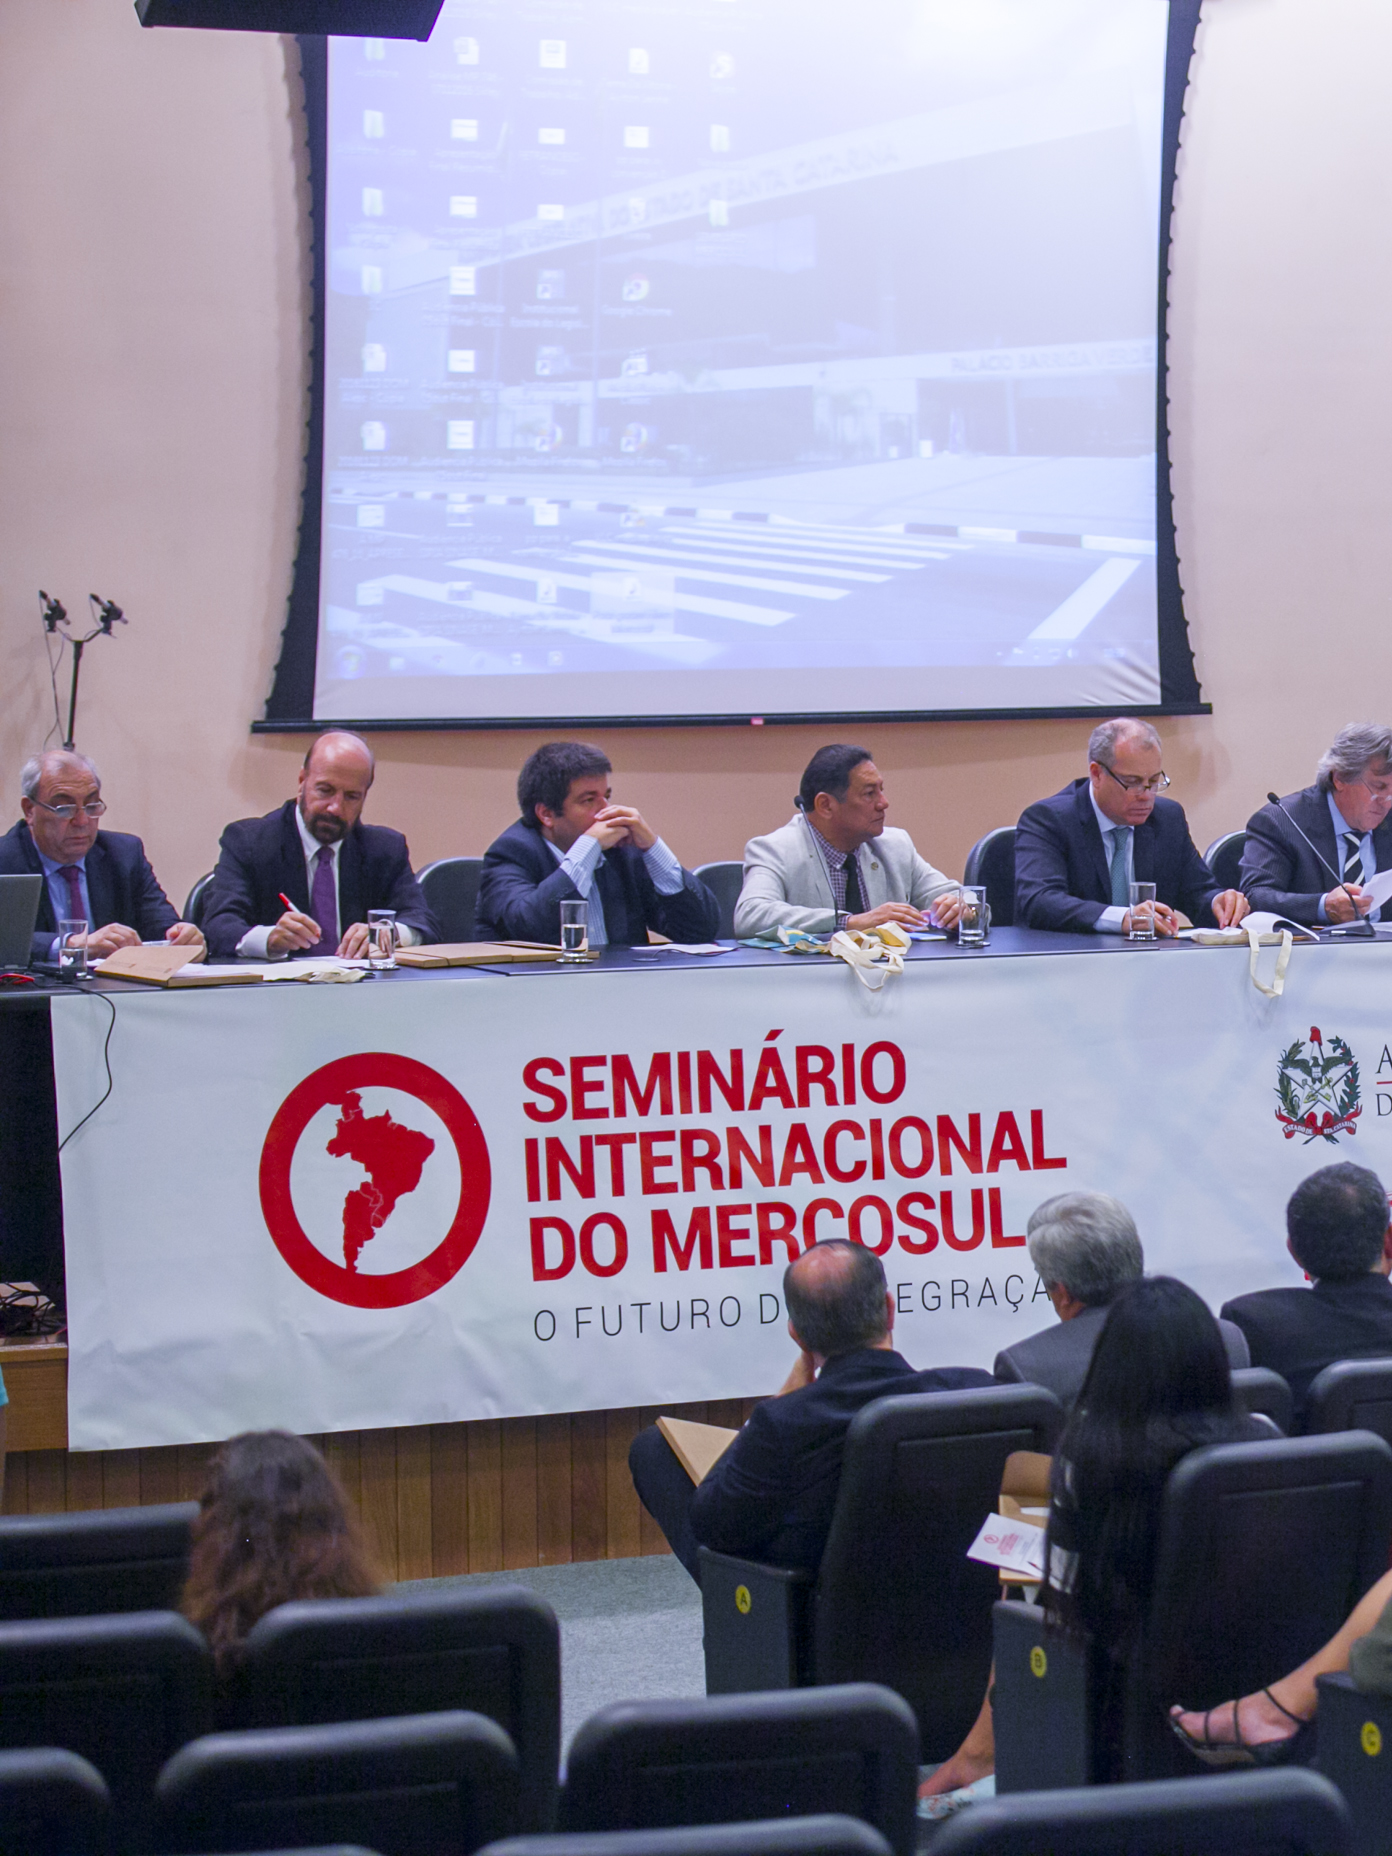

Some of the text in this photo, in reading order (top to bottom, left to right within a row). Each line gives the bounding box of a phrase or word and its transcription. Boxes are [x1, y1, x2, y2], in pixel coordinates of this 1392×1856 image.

[523, 1028, 906, 1123] SEMINÁRIO
[525, 1109, 1067, 1202] INTERNACIONAL
[530, 1187, 1026, 1282] DO MERCOSUL
[534, 1310, 556, 1341] O
[575, 1296, 741, 1339] FUTURO
